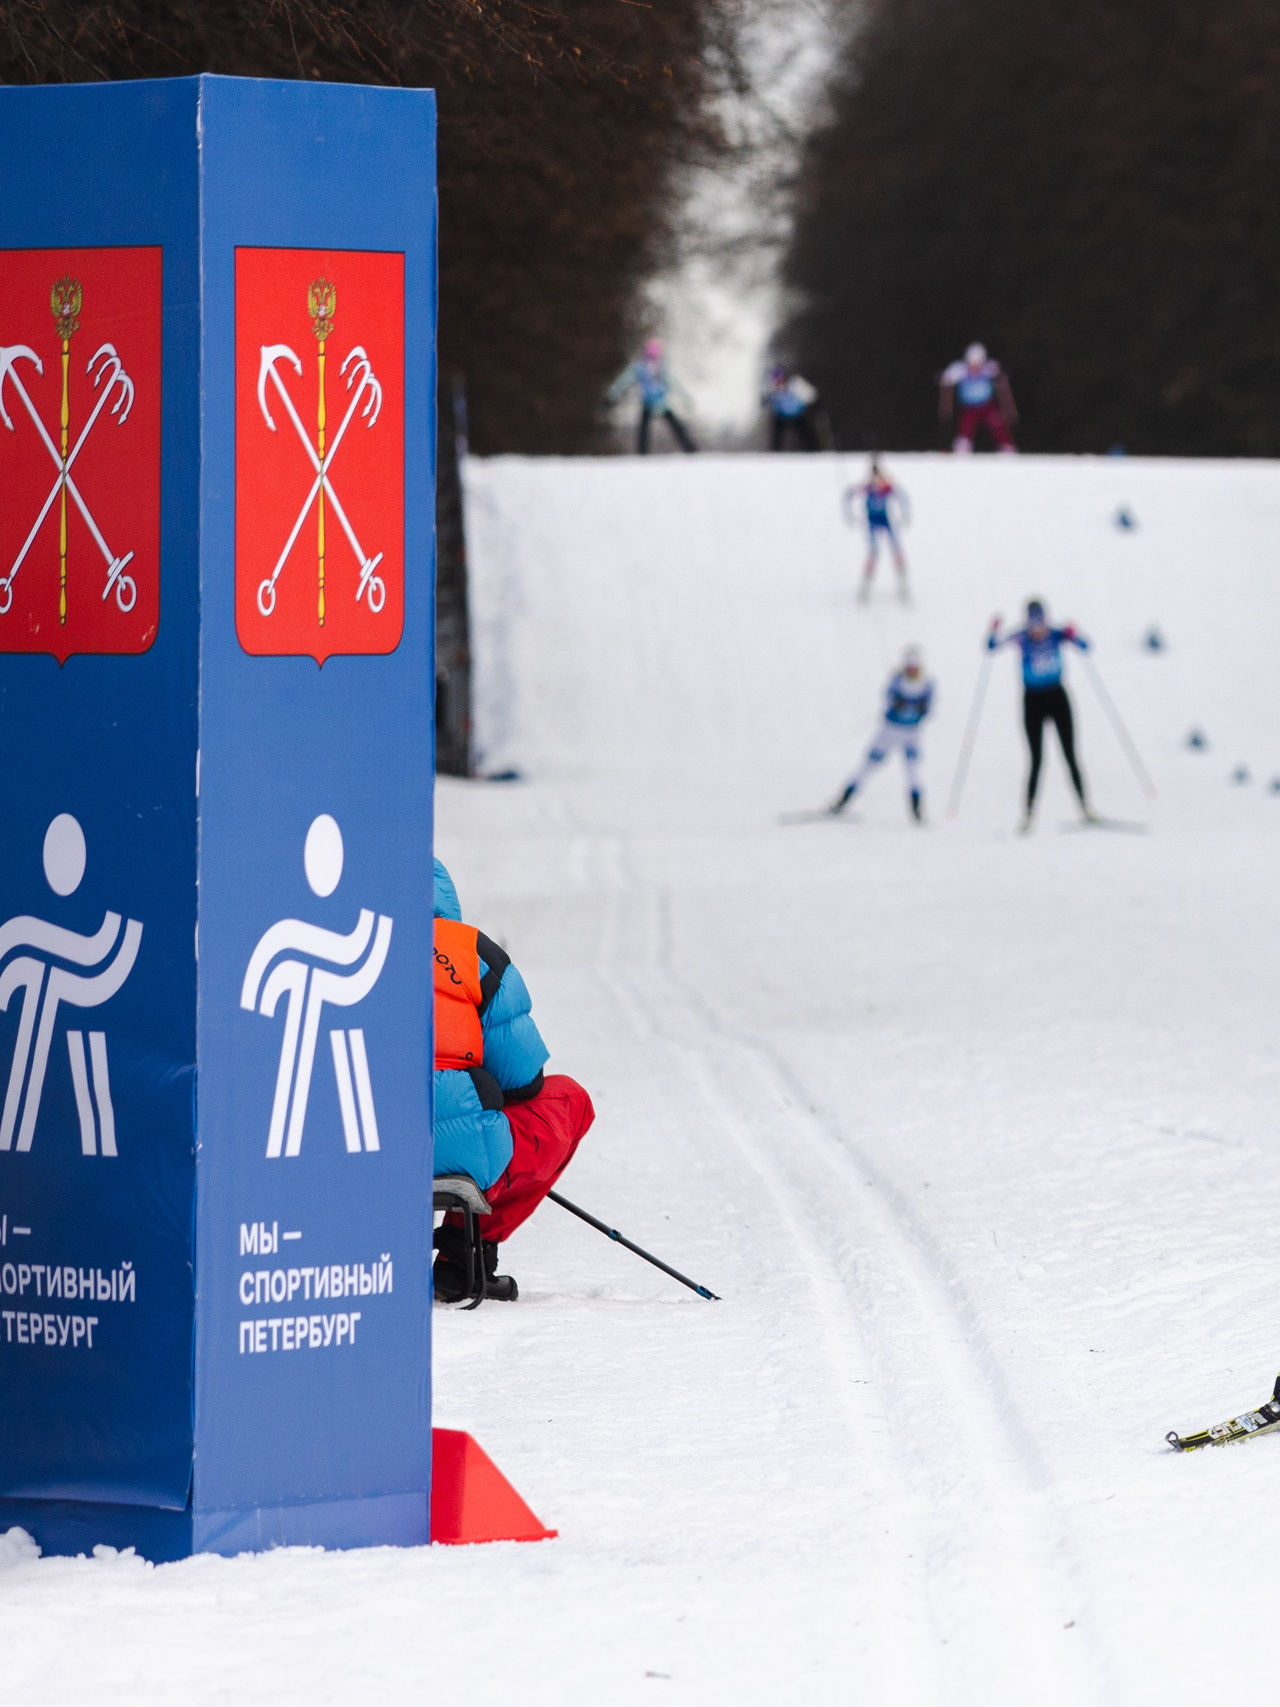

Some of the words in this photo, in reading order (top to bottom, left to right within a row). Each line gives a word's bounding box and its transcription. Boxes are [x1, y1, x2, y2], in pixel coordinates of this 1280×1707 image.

[239, 1221, 278, 1257] МЫ
[0, 1260, 136, 1302] ОРТИВНЫЙ
[239, 1252, 394, 1306] СПОРТИВНЫЙ
[0, 1310, 99, 1349] ТЕРБУРГ
[239, 1311, 361, 1354] ПЕТЕРБУРГ
